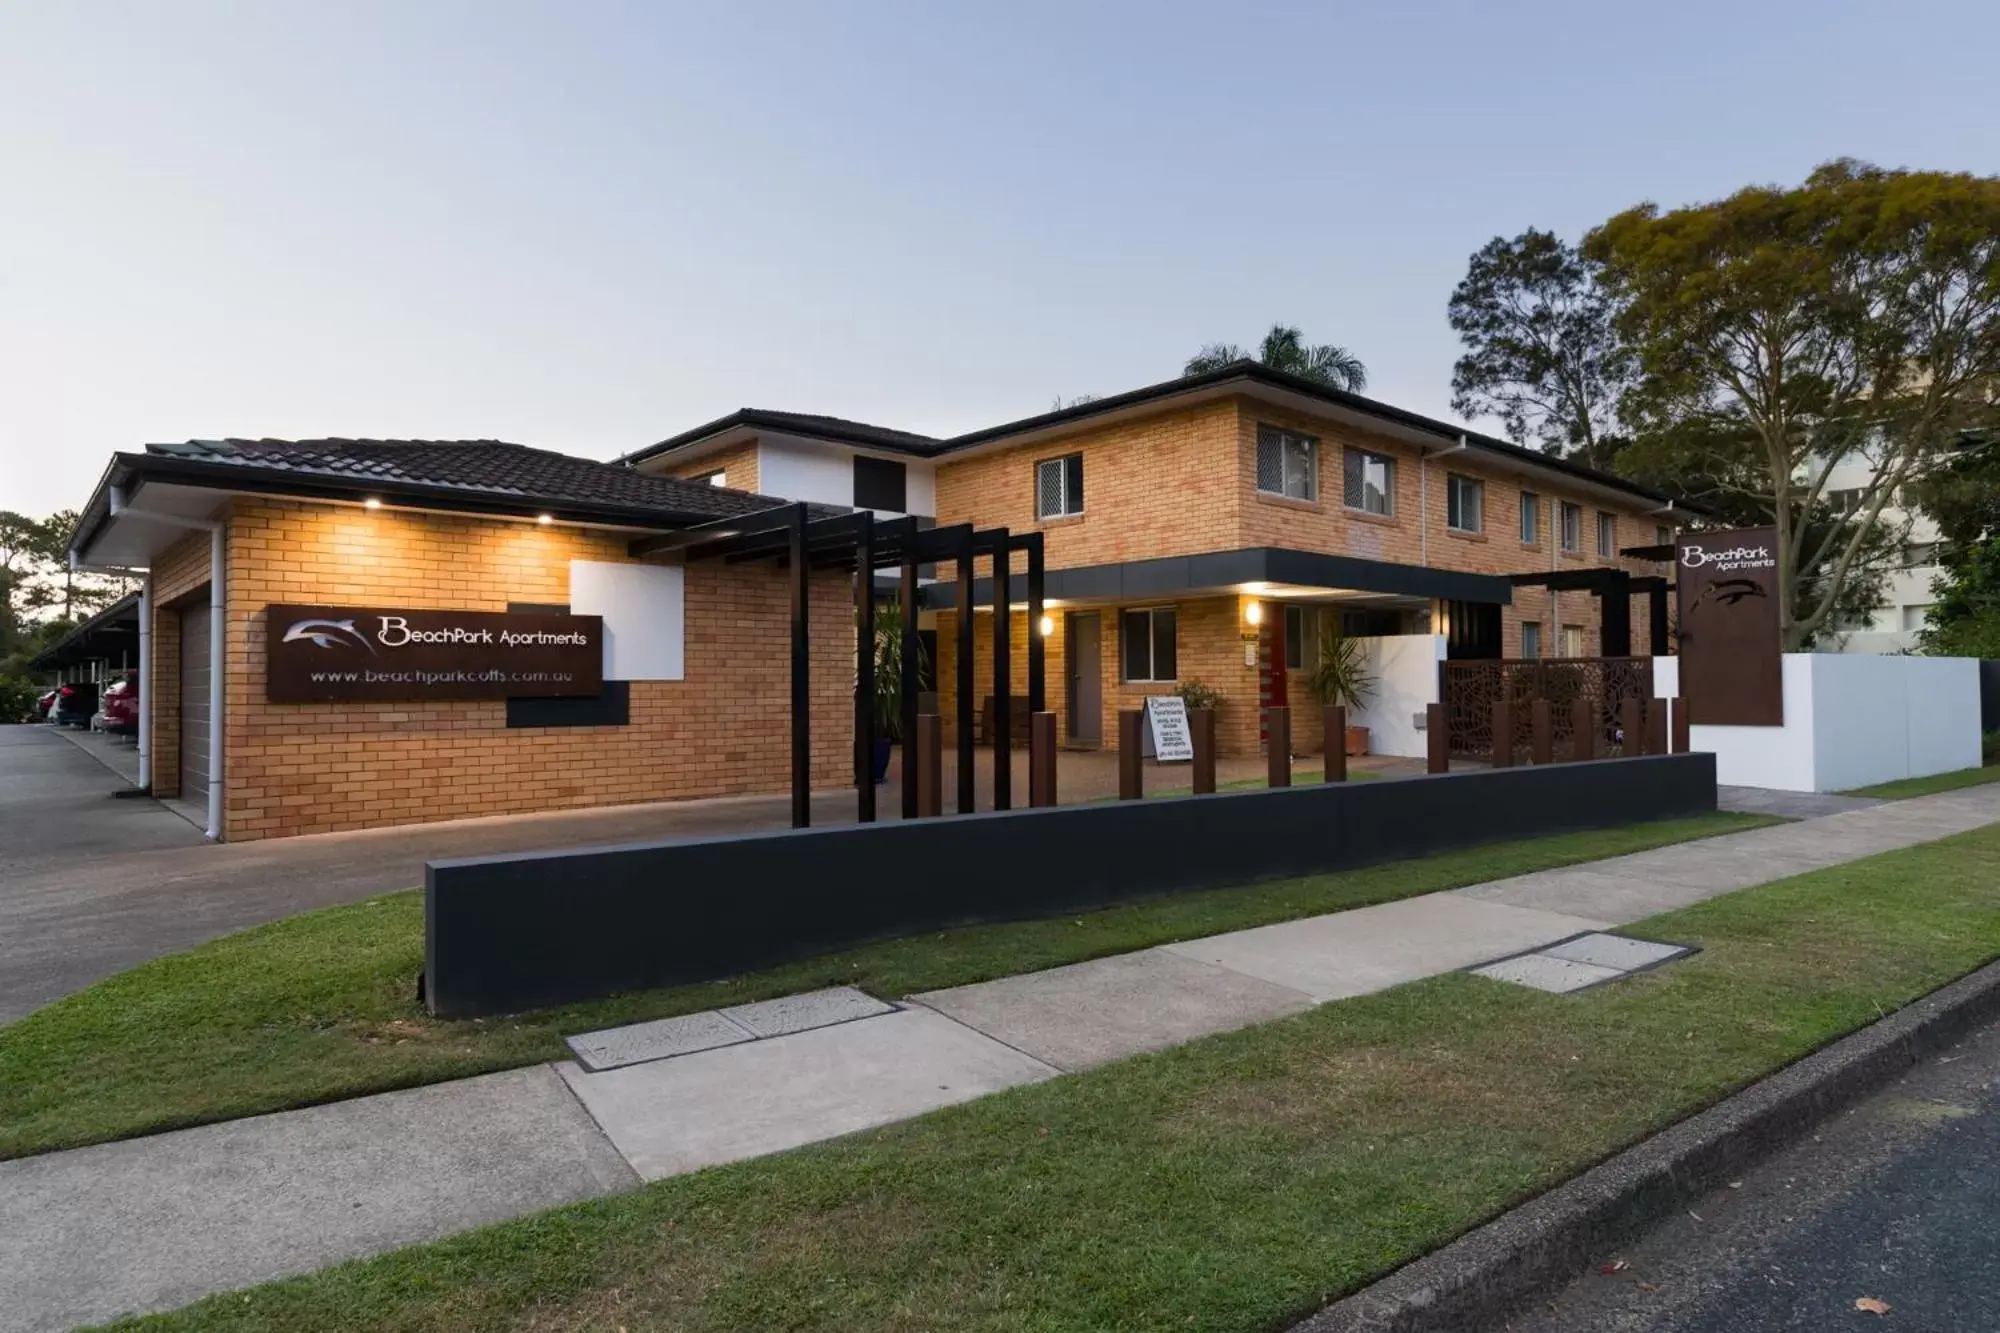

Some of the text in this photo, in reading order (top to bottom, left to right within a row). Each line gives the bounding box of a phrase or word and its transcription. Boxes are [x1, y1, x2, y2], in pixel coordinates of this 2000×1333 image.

[1681, 546, 1768, 568] BeachPark
[1716, 559, 1776, 571] Apartments
[377, 616, 588, 647] BeachPark Apartments
